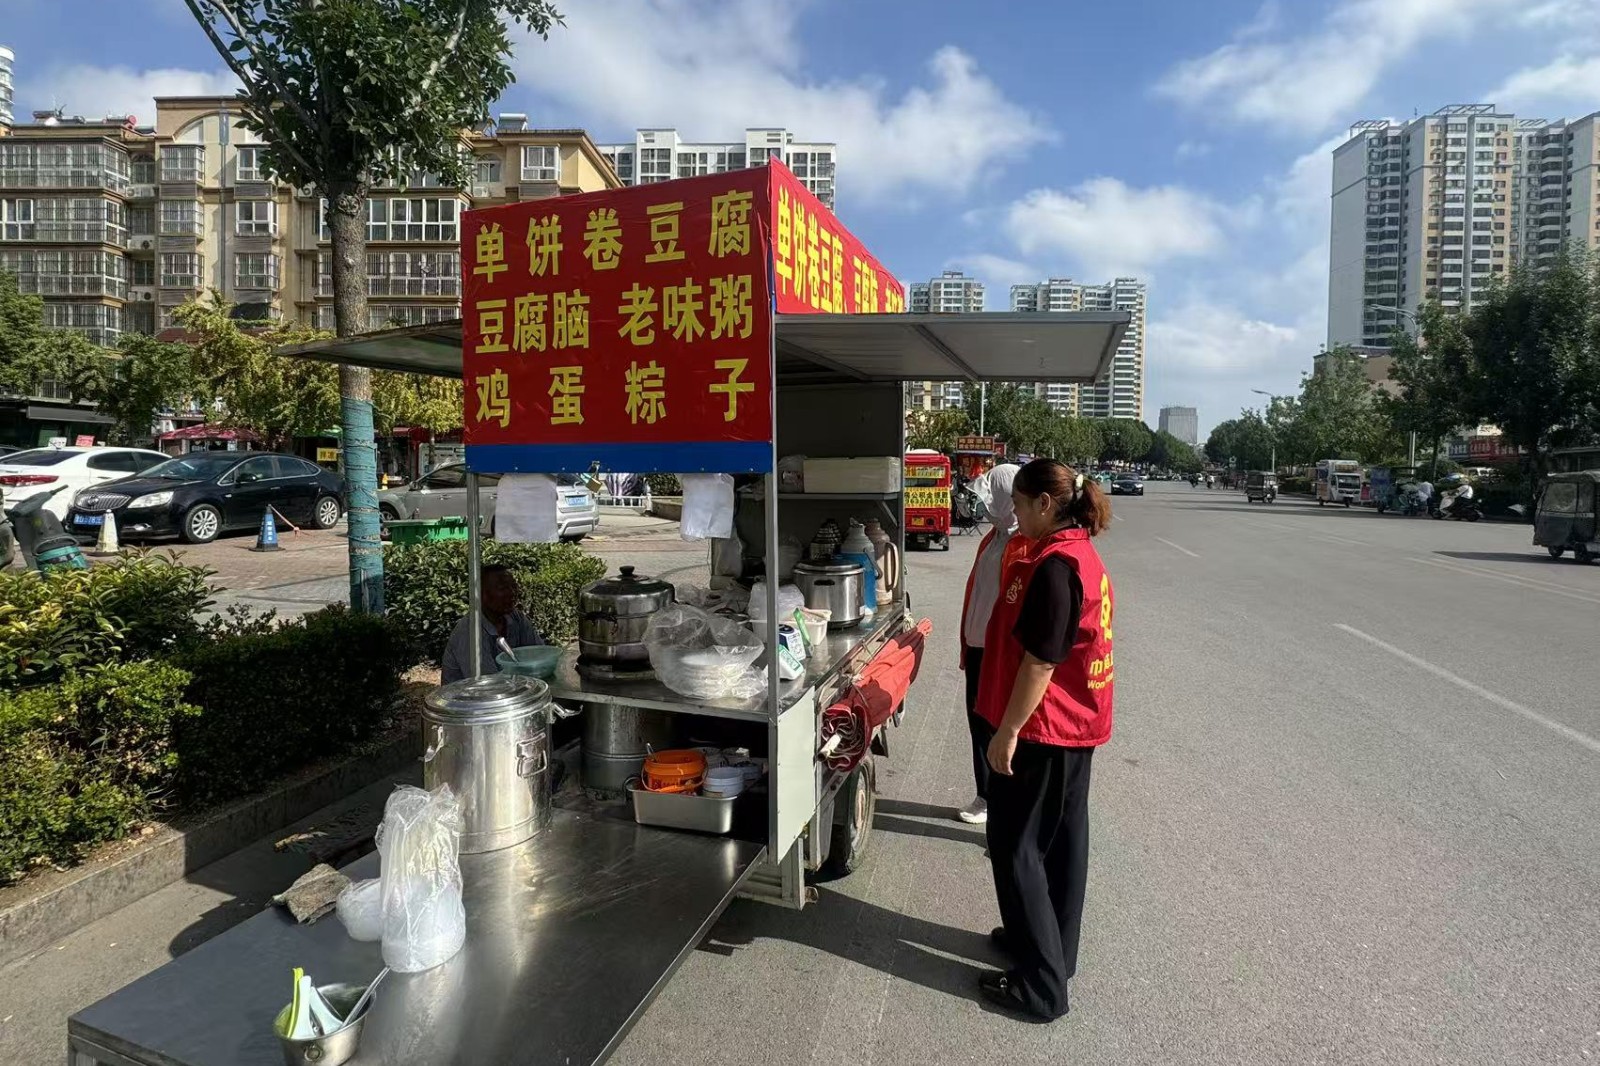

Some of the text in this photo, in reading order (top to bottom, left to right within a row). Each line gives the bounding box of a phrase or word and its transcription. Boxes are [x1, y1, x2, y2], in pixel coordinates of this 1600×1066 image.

[473, 190, 753, 283] 单饼卷豆腐
[475, 275, 753, 354] 豆腐脑 老味粥
